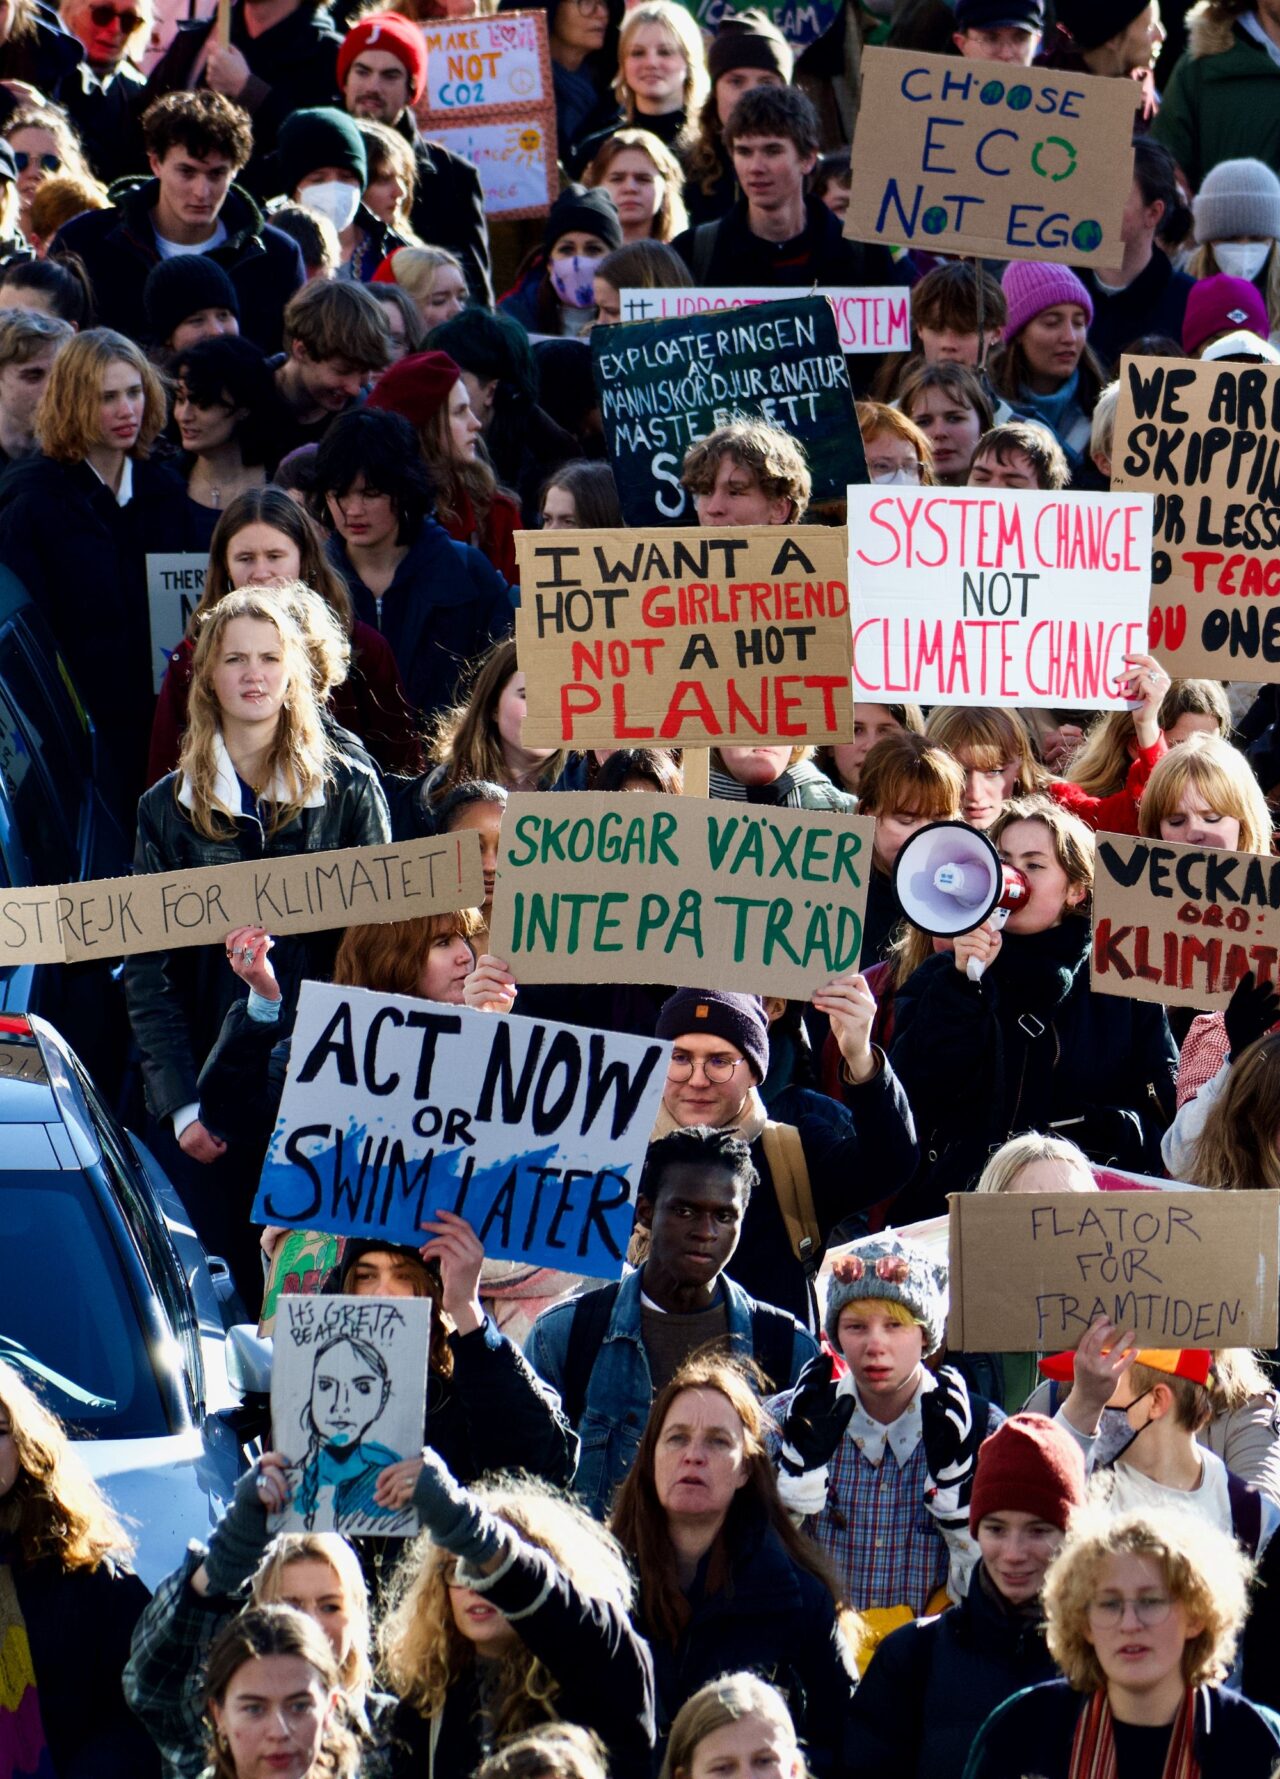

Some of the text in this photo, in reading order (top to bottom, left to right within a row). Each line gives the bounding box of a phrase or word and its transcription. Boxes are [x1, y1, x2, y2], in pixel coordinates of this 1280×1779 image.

[426, 31, 480, 54] MAKE
[448, 52, 502, 82] NOT
[438, 83, 485, 106] CO2
[901, 68, 1085, 118] CHOOSE
[875, 178, 1104, 253] NOT EGO
[830, 297, 908, 346] YSTEM
[599, 314, 816, 380] EXPLOATERINGEN
[688, 358, 713, 379] AV
[711, 369, 768, 400] DJUR
[1128, 363, 1196, 424] WE
[615, 411, 707, 457] MÅSTE
[760, 392, 821, 429] ETT
[856, 497, 1144, 572] SYSTEM CHANGE
[1153, 494, 1186, 545] UR
[160, 569, 208, 591] THER
[534, 538, 817, 588] I WANT A
[1152, 551, 1172, 585] O
[535, 580, 849, 638] HOT GIRLFRIEND
[962, 571, 1041, 618] NOT
[1148, 604, 1186, 652] OU
[571, 626, 816, 682] NOT A HOT
[853, 618, 1020, 697] CLIMATE
[560, 675, 849, 740] PLANET
[508, 811, 863, 889] SKOGAR VÄXER
[3, 891, 143, 948] STREJK
[162, 883, 231, 935] FÖR
[511, 889, 863, 972] INTE PÅ TRÄD
[296, 1001, 663, 1141] ACT NOW
[412, 1106, 477, 1146] OR
[263, 1124, 435, 1232] SWIM
[1031, 1206, 1203, 1244] FLATOR
[1076, 1241, 1163, 1284] FÖR
[324, 1301, 406, 1333] GRETA
